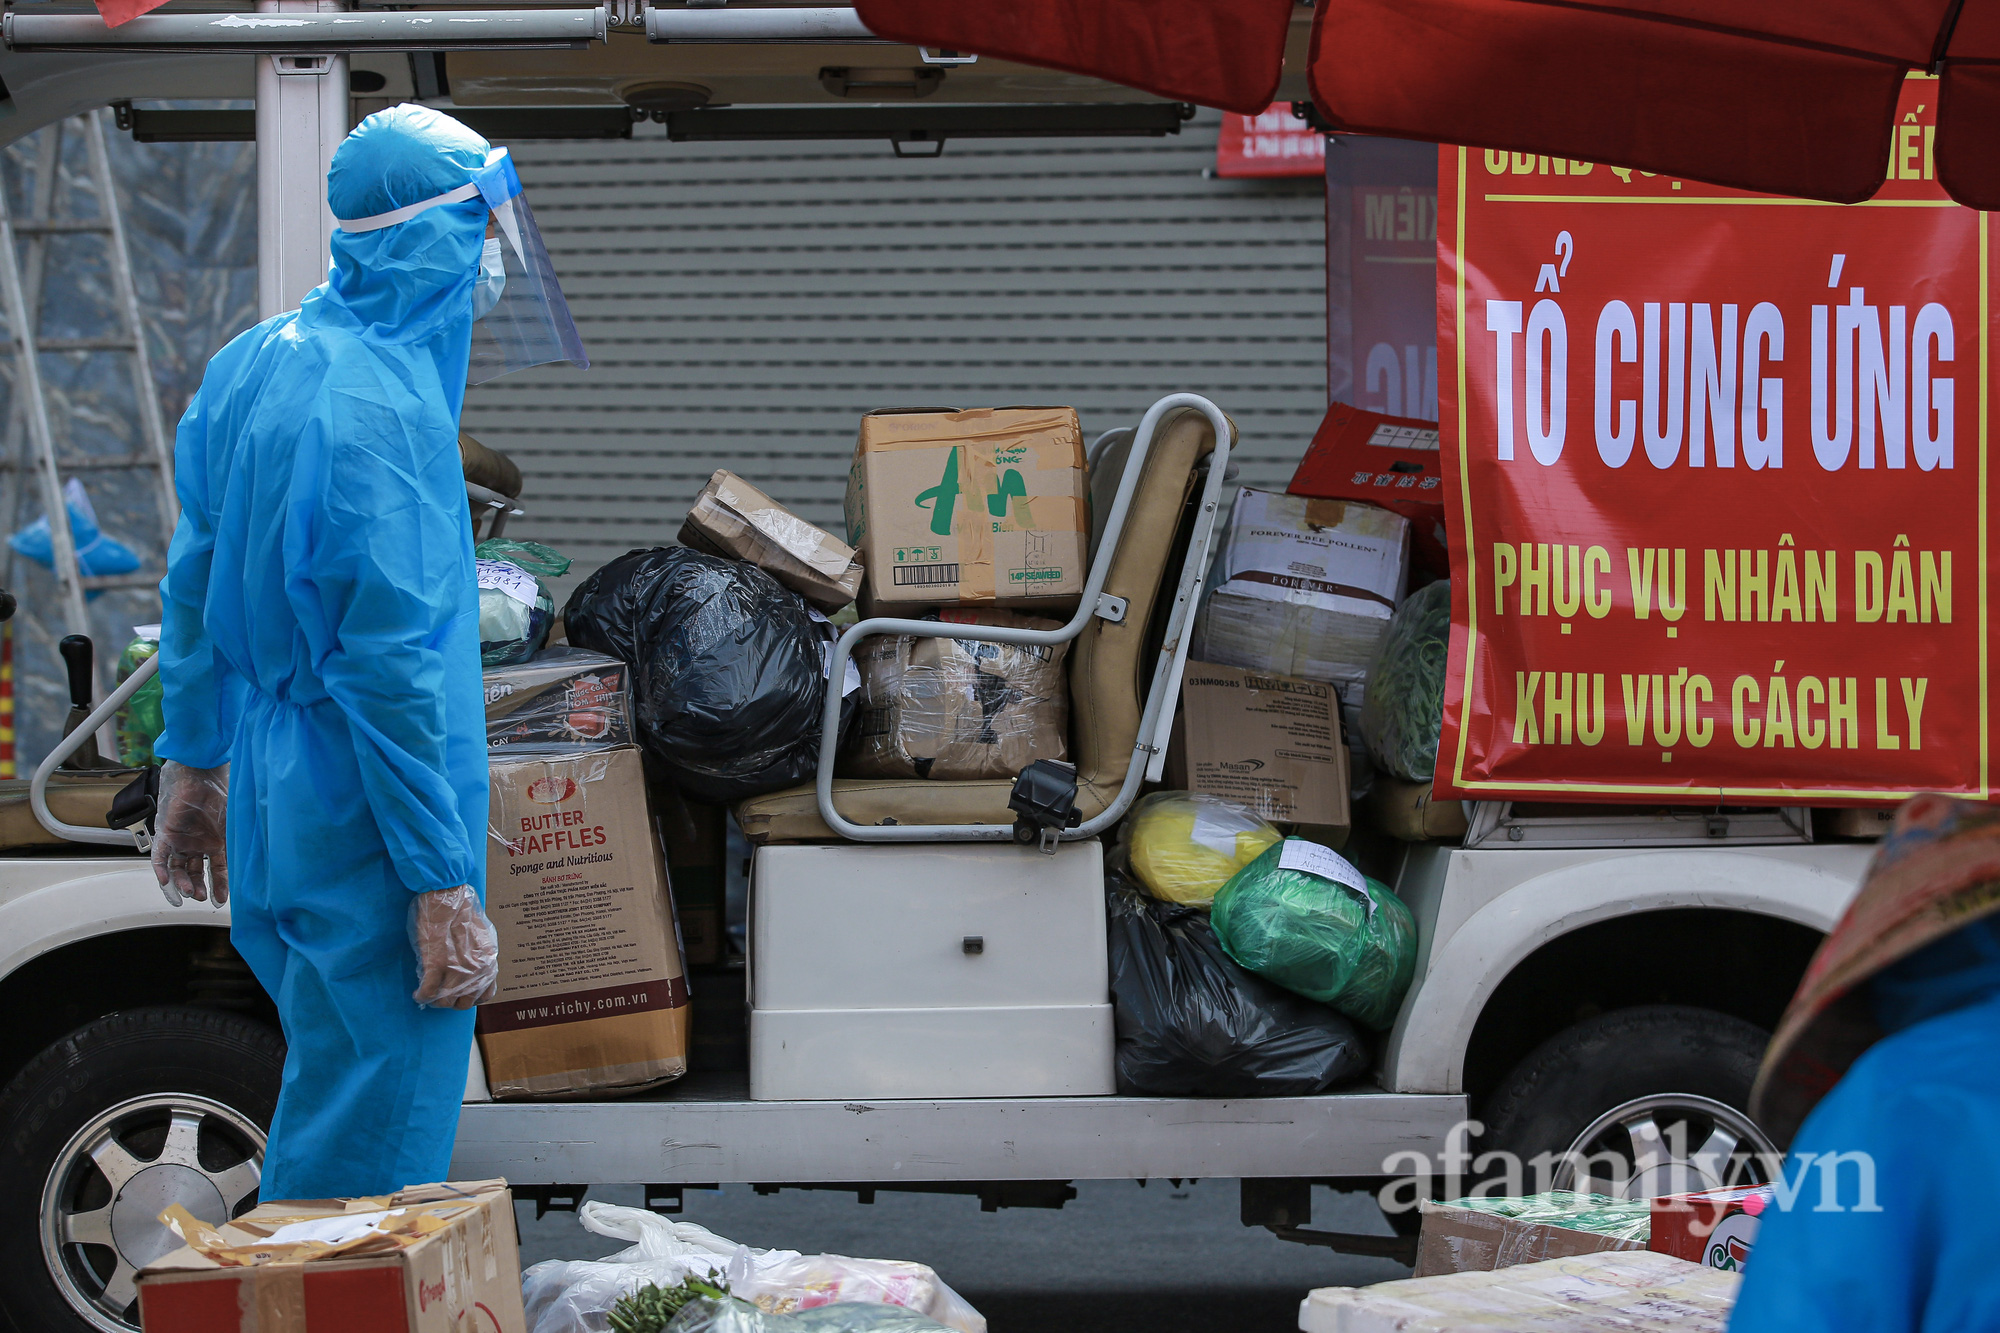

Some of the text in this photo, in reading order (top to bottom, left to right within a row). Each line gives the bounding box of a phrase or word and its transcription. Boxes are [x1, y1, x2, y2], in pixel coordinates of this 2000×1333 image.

[1486, 231, 1955, 472] TỔ CUNG ỨNG
[1250, 530, 1302, 541] FOREVER
[1304, 535, 1326, 544] BEE
[1010, 570, 1061, 581] 14P SEAWEED
[1494, 533, 1952, 638] PHỤC VỤ NHÂN DÂN
[484, 683, 514, 705] iền
[1189, 677, 1240, 688] 03NM00585
[1512, 660, 1928, 762] KHU VỰC CÁCH LY
[492, 736, 510, 748] CAY
[1219, 762, 1250, 771] Masan
[520, 809, 584, 832] BUTTER
[506, 825, 608, 858] WAFFLES
[509, 851, 613, 876] Sponge and Nutritious
[516, 990, 648, 1021] www.richy.com.vn
